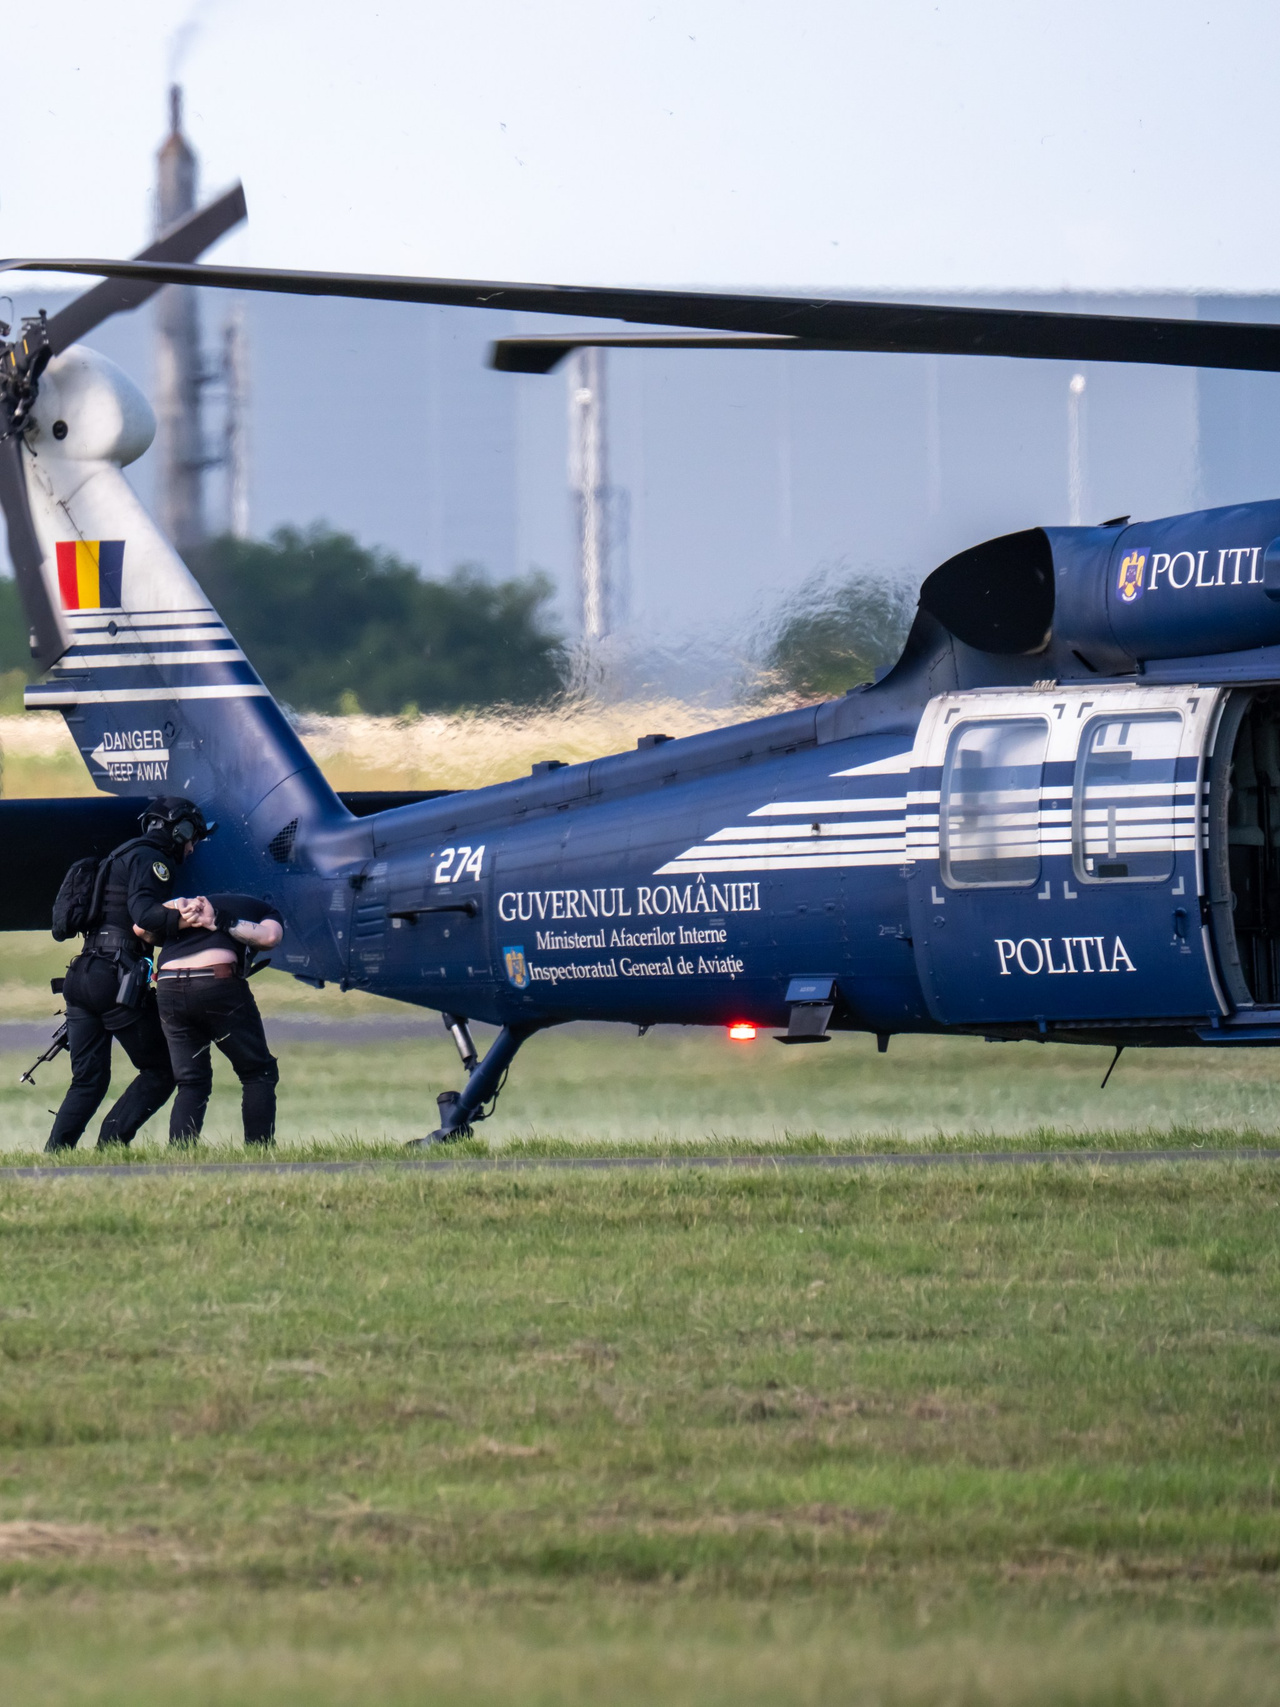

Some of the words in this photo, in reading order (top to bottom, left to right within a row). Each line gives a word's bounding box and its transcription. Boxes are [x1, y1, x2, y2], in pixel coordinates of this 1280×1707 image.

[1147, 546, 1265, 590] POLITI
[103, 730, 164, 750] DANGER
[108, 763, 134, 781] KEEP
[137, 762, 168, 781] AWAY
[434, 845, 486, 884] 274
[498, 887, 632, 922] GUVERNUL
[637, 873, 761, 916] ROMÂNIEI
[535, 928, 606, 950] Ministerul
[610, 926, 676, 947] Afacerilor
[678, 925, 728, 945] Interne
[994, 935, 1138, 975] POLITIA
[527, 958, 618, 986] Inspectoratul
[620, 956, 675, 977] General
[677, 956, 695, 975] de
[698, 954, 745, 981] Aviație
